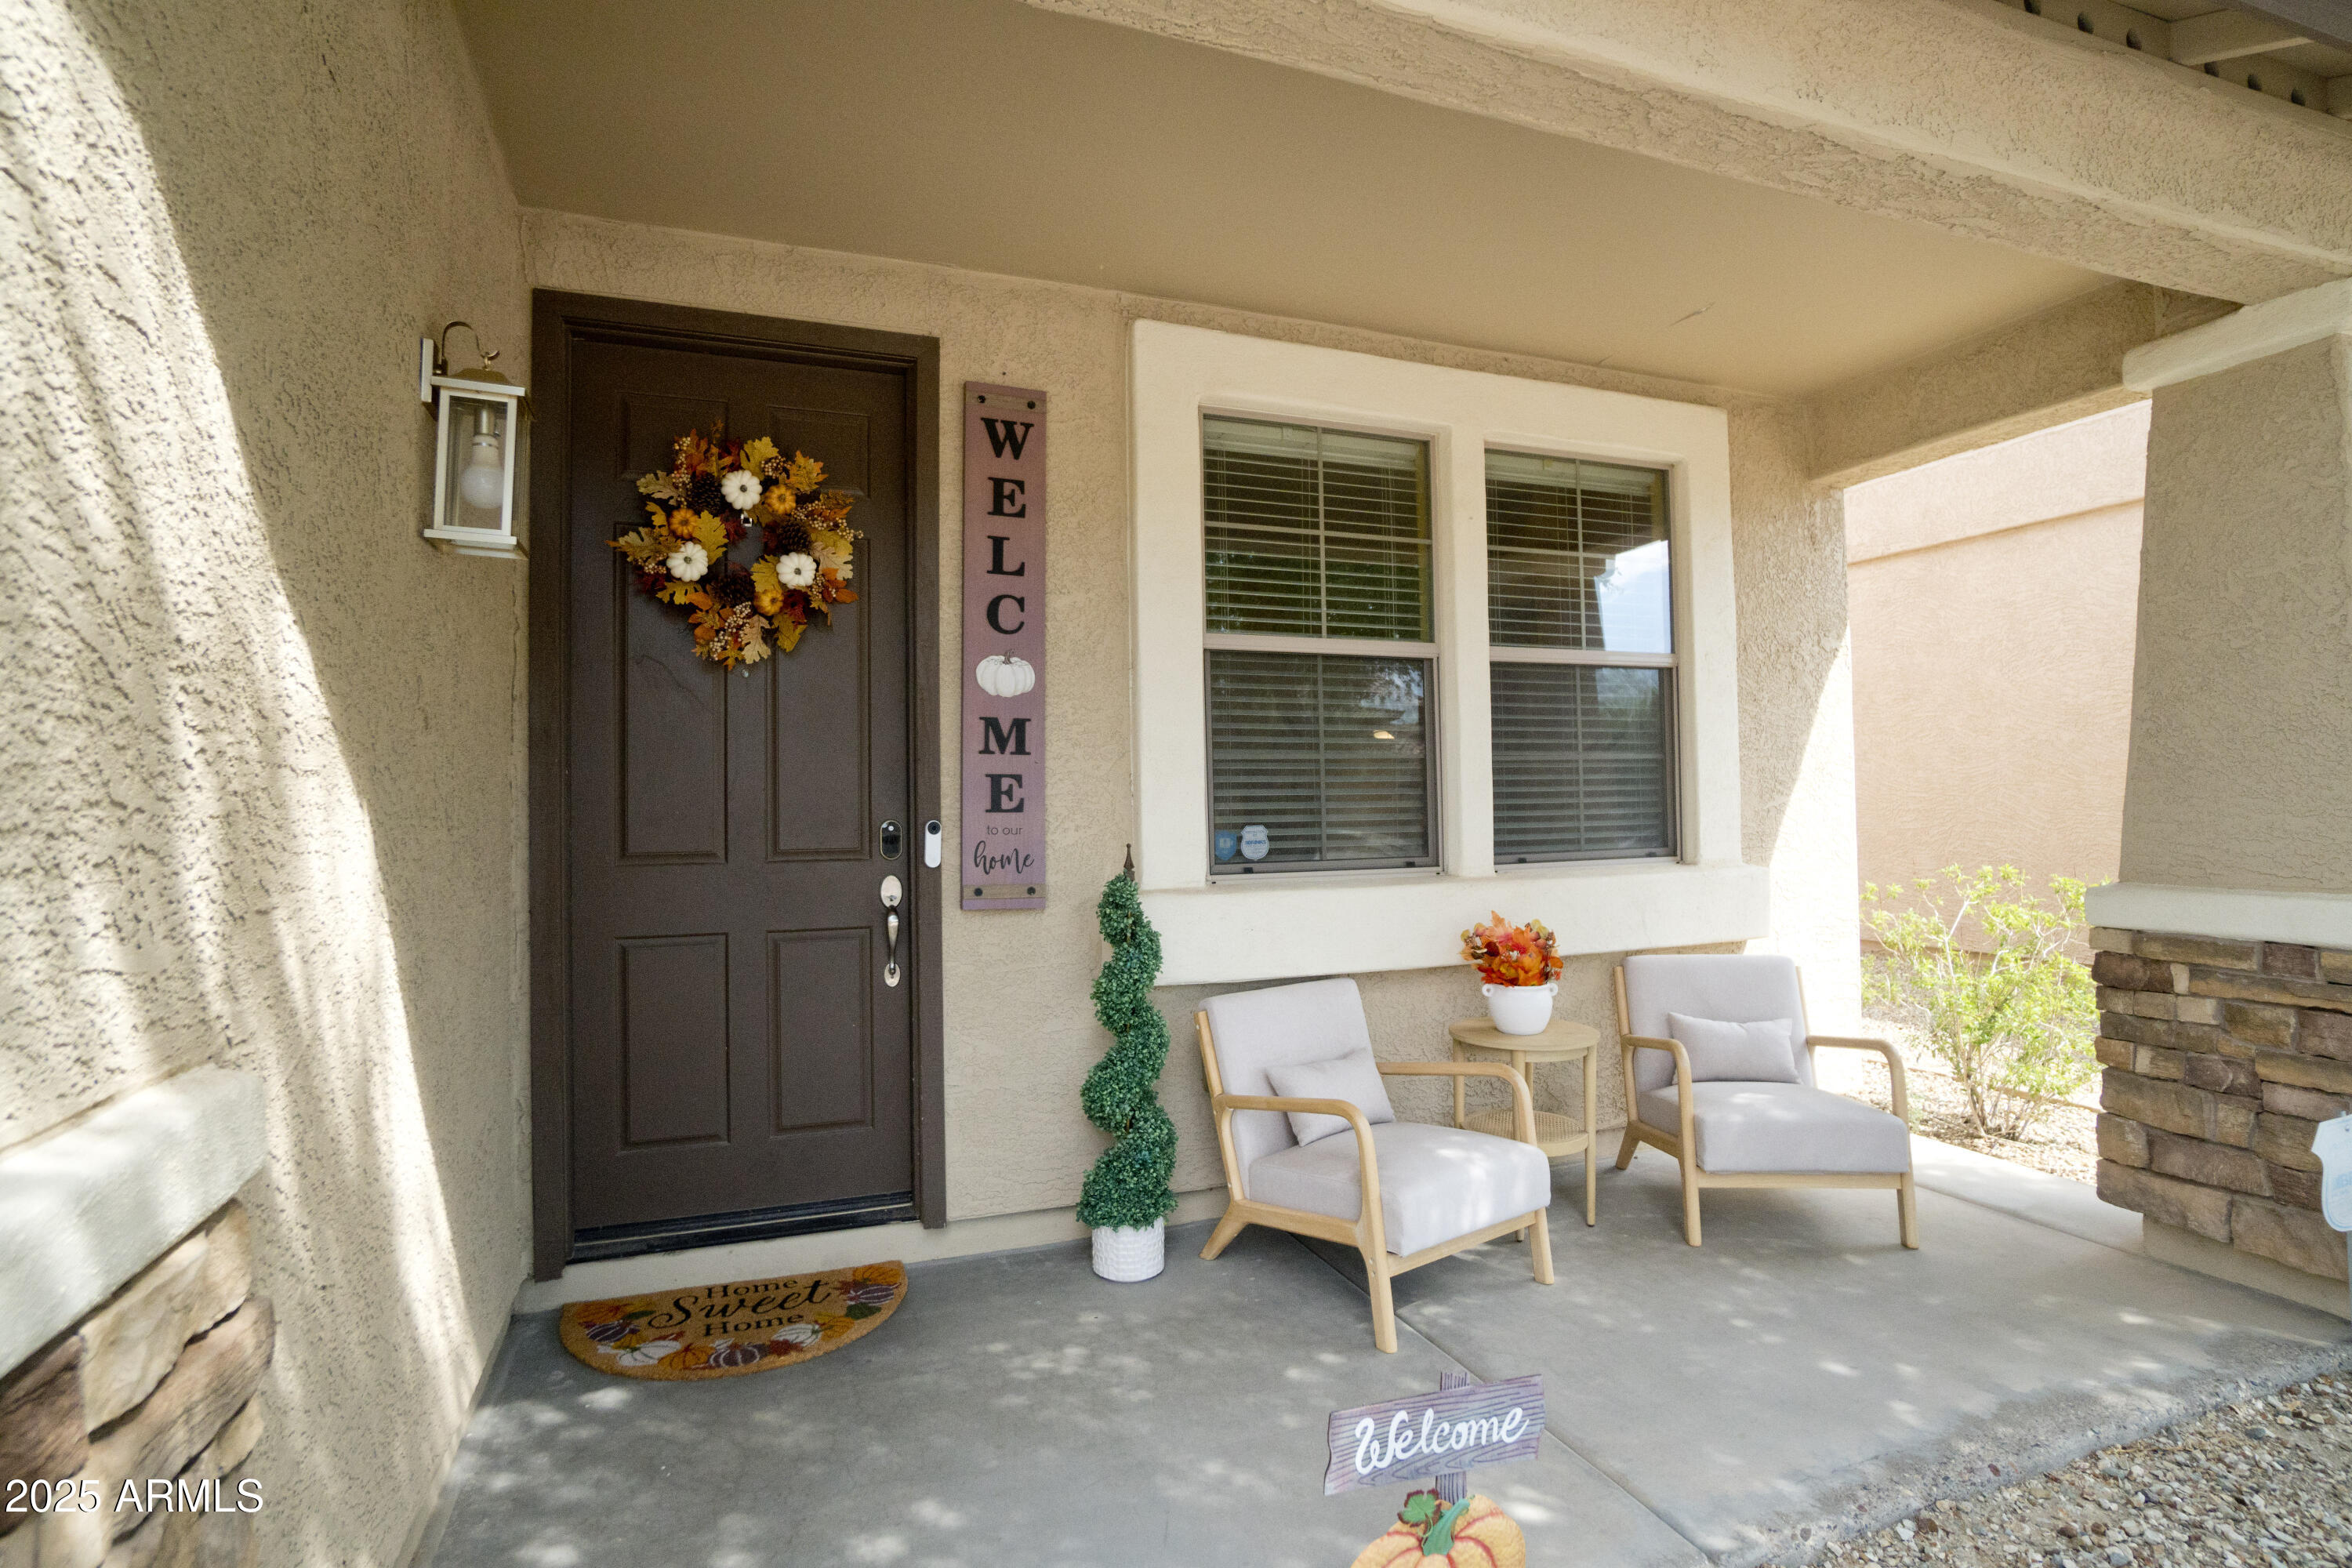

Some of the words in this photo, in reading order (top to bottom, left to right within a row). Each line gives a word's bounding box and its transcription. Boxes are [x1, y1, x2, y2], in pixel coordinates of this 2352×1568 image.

[977, 416, 1035, 813] WELCME
[986, 825, 999, 836] to
[1002, 826, 1023, 836] our
[974, 840, 1035, 875] home
[648, 1279, 833, 1329] Sweet
[706, 1279, 799, 1300] Home
[702, 1312, 804, 1337] Home
[1355, 1407, 1530, 1475] Welcome
